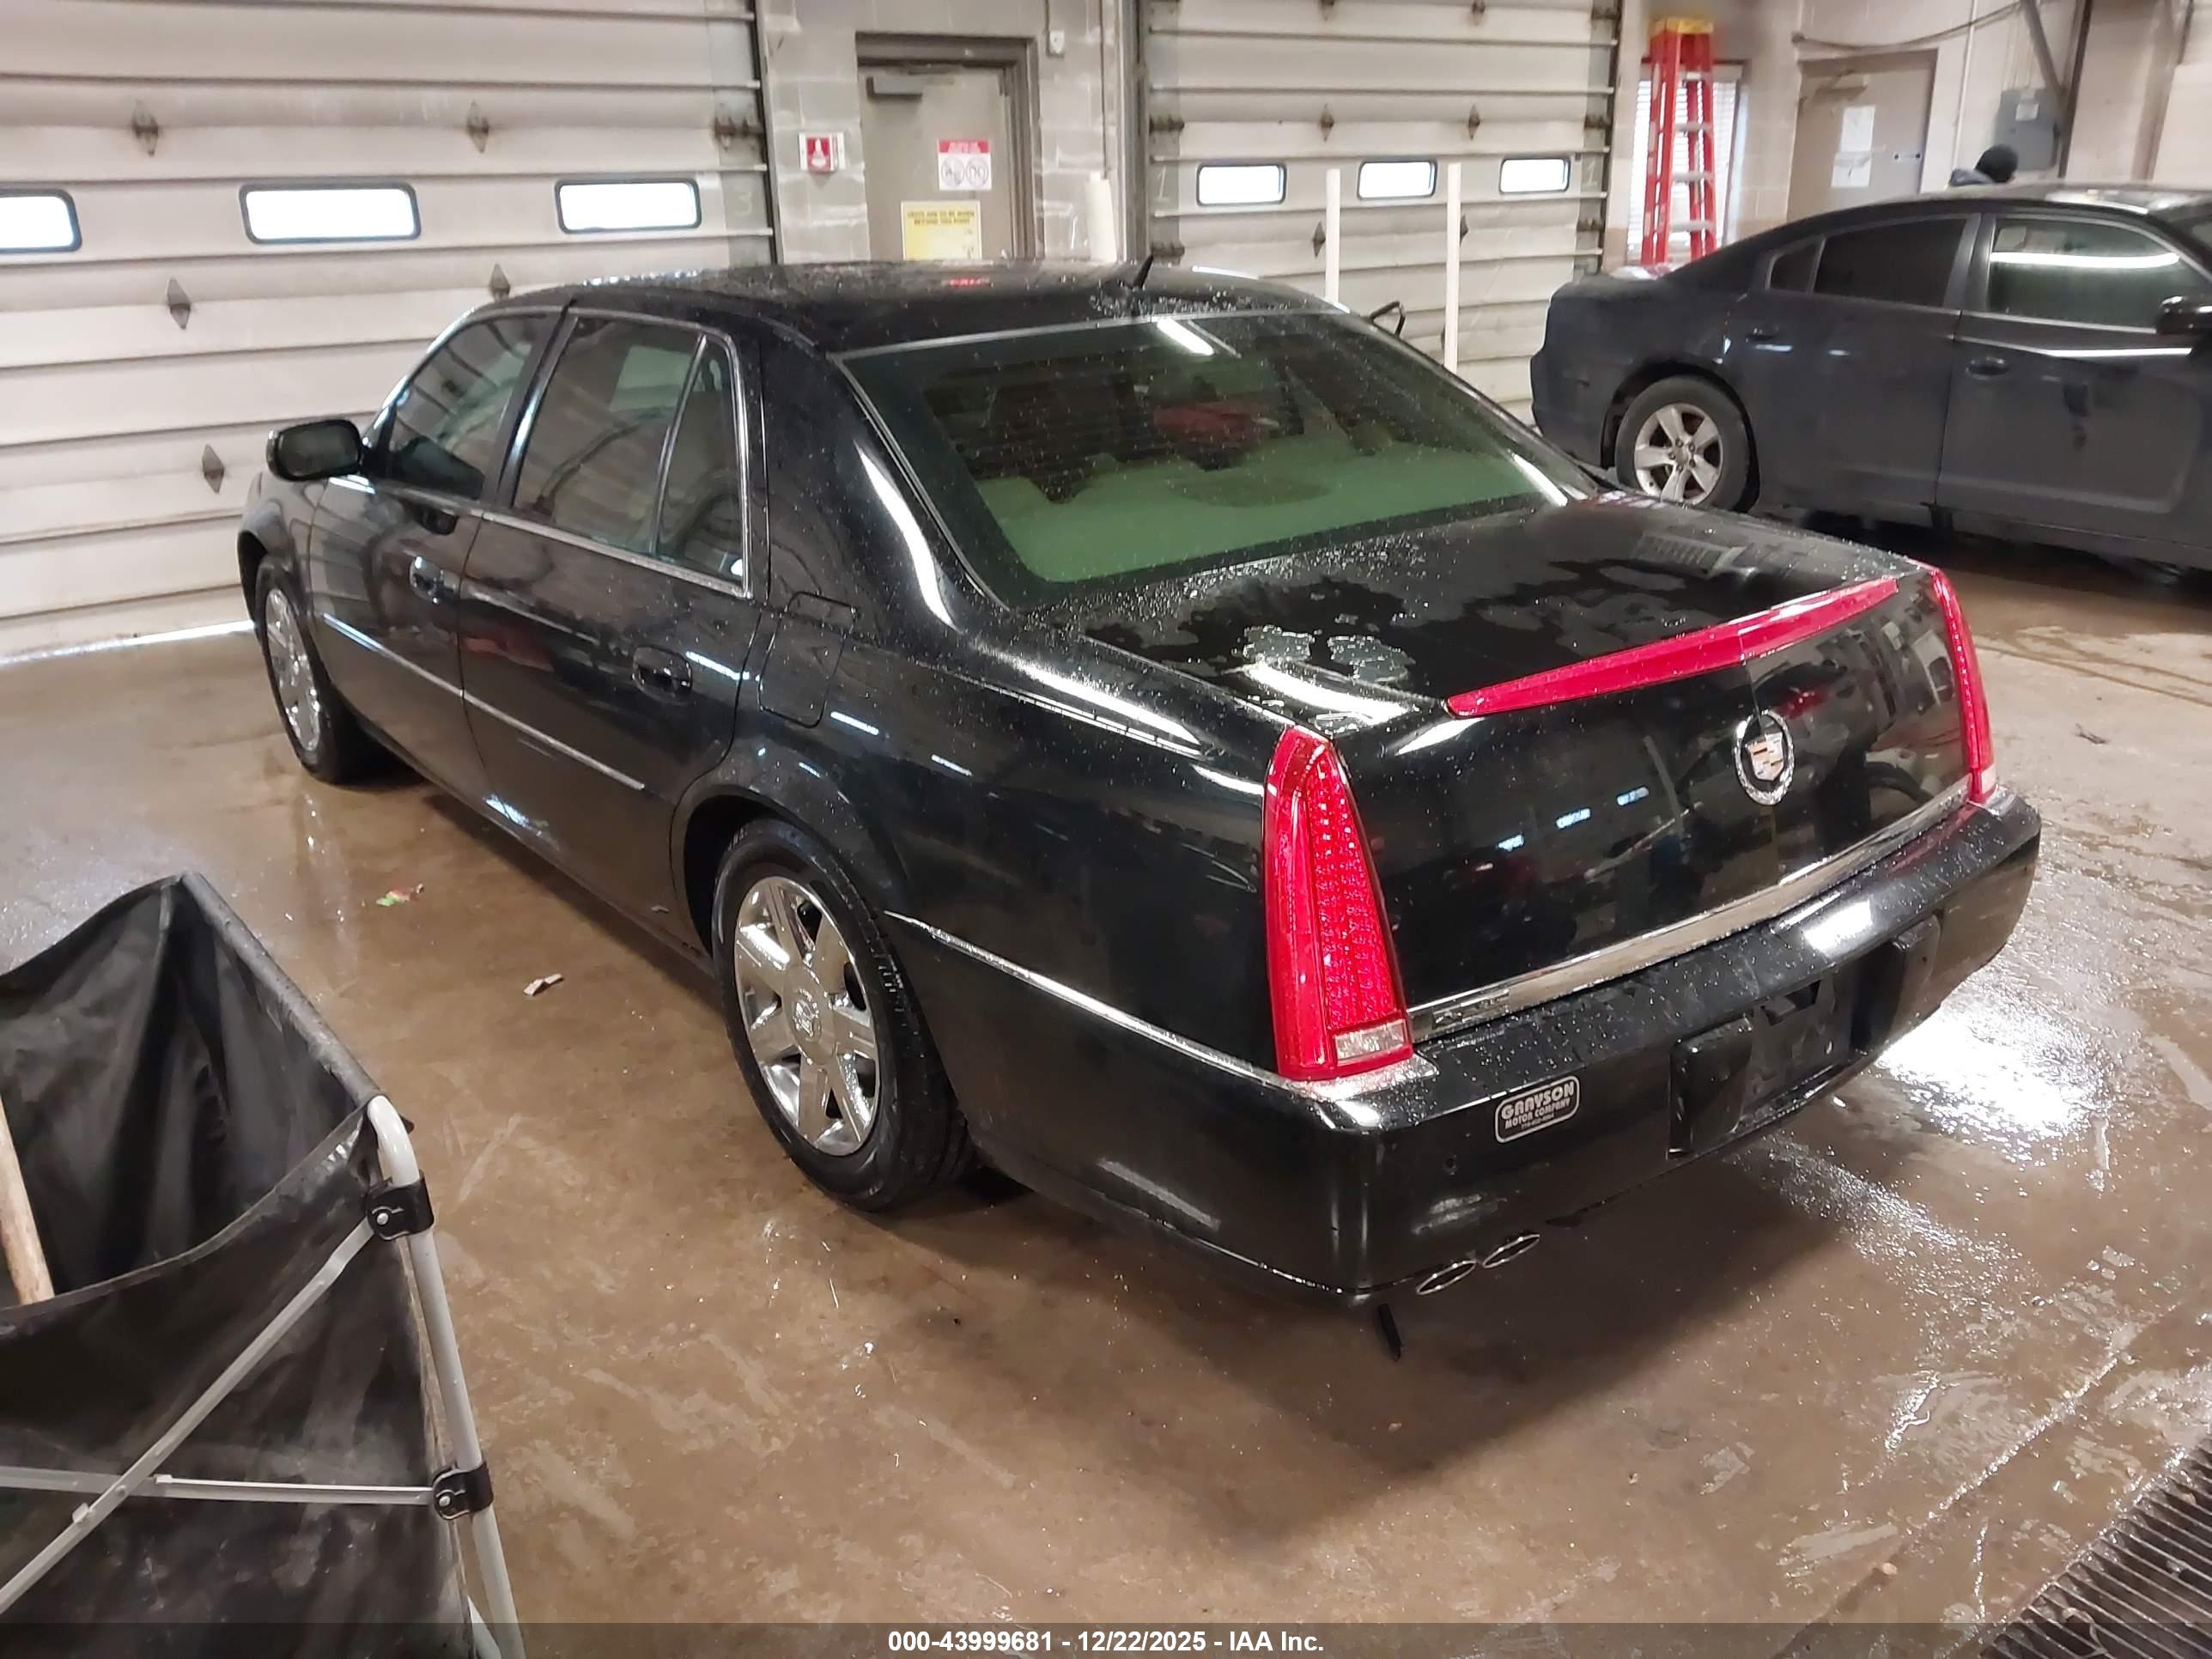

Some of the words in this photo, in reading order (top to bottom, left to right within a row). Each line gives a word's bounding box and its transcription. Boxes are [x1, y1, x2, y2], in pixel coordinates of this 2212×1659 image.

[1501, 1081, 1575, 1120] GRAYSON
[1504, 1111, 1534, 1130] MOTOR
[1534, 1097, 1571, 1118] COMPANY
